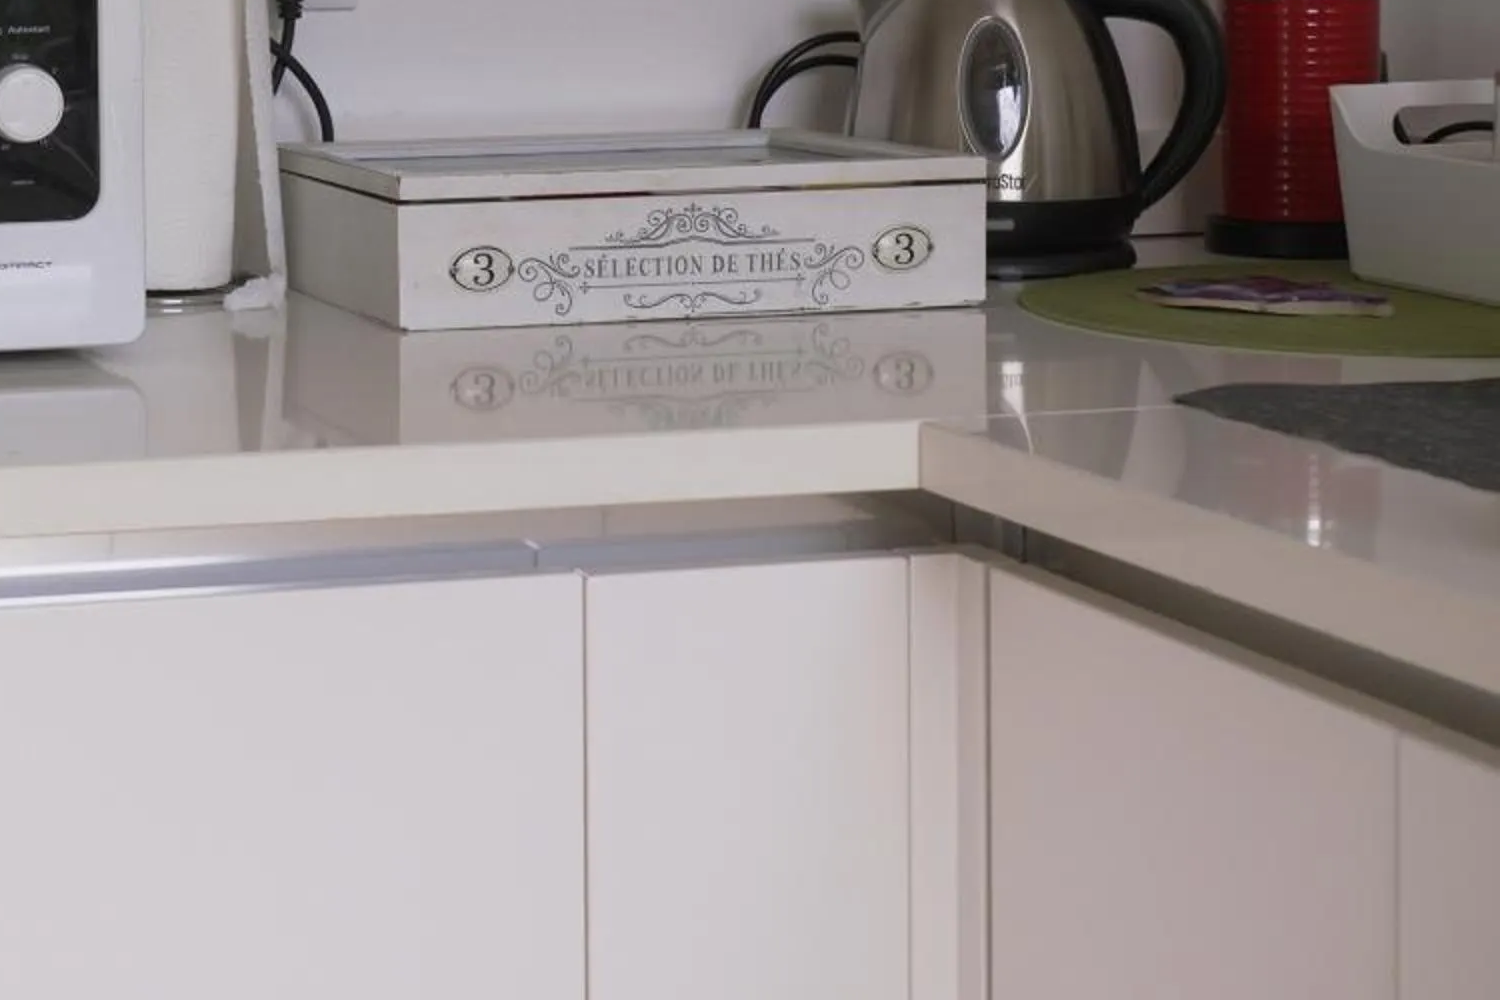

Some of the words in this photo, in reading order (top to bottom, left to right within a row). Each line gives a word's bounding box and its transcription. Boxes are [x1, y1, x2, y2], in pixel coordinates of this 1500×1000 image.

[582, 253, 704, 279] SÉLECTION
[711, 253, 739, 274] DE
[745, 247, 802, 273] THÉS
[894, 232, 915, 265] 3
[473, 252, 496, 287] 3
